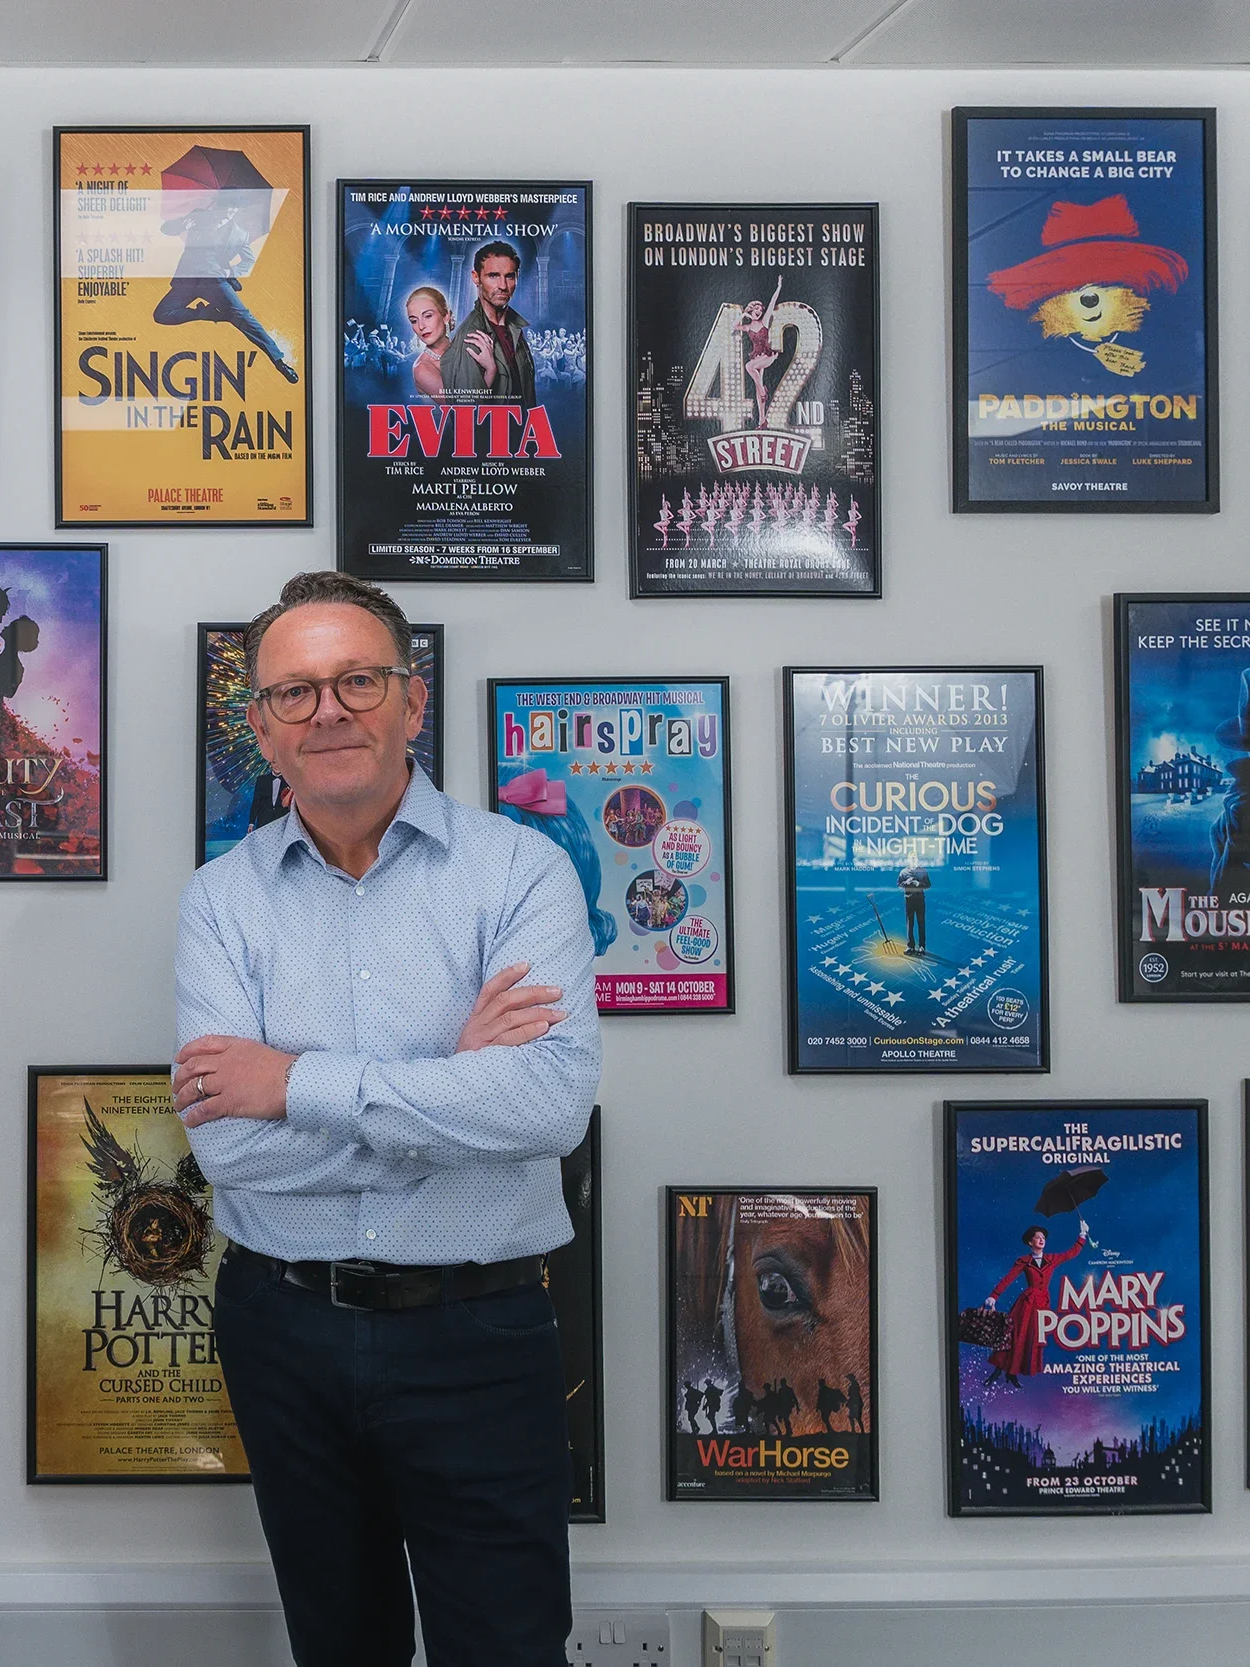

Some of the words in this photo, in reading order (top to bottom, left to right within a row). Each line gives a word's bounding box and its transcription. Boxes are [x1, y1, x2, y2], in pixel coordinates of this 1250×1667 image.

[997, 151, 1011, 163] IT
[1016, 151, 1065, 163] TAKES
[1068, 151, 1079, 163] A
[1082, 151, 1133, 163] SMALL
[1136, 151, 1176, 163] BEAR
[644, 223, 743, 242] BROADWAY’S
[750, 223, 815, 243] BIGGEST
[821, 224, 865, 243] SHOW
[644, 247, 664, 267] ON
[671, 247, 744, 267] LONDON’S
[751, 247, 814, 267] BIGGEST
[821, 248, 866, 267] STAGE
[684, 300, 823, 433] 42
[127, 406, 150, 428] IN
[154, 406, 198, 428] THE
[796, 401, 825, 426] ND
[202, 406, 293, 460] RAIN
[367, 404, 562, 459] EVITA
[717, 435, 804, 469] STREET
[412, 483, 459, 495] MARTI
[462, 483, 518, 496] PELLOW
[1052, 482, 1083, 491] SAVOY
[1085, 482, 1128, 491] THEATRE
[148, 489, 182, 503] PALACE
[185, 489, 223, 503] THEATRE
[416, 502, 468, 512] MADALENA
[470, 502, 513, 512] ALBERTO
[1195, 618, 1221, 632] SEE
[1226, 619, 1239, 632] IT
[1138, 635, 1174, 649] KEEP
[1180, 635, 1209, 649] THE
[820, 684, 1008, 712] WINNER!
[504, 708, 717, 758] hairspray
[821, 737, 875, 753] BEST
[885, 737, 940, 753] NEW
[951, 737, 1008, 753] PLAY
[830, 780, 997, 812] CURIOUS
[825, 815, 921, 834] INCIDENT
[938, 813, 1003, 835] DOG
[1143, 963, 1166, 973] 1952
[616, 981, 635, 994] MON
[637, 982, 643, 994] 9
[650, 981, 664, 994] SAT
[667, 981, 676, 994] 14
[678, 981, 715, 994] OCTOBER
[873, 1036, 964, 1047] CuriousOnStage.com
[881, 1050, 915, 1058] APOLLO
[918, 1050, 956, 1058] THEATRE
[1064, 1123, 1088, 1134] THE
[971, 1133, 1182, 1153] SUPERCALIFRAGILISTIC
[1042, 1153, 1110, 1164] ORIGINAL
[1061, 1272, 1165, 1312] MARY
[1036, 1305, 1185, 1349] POPPINS
[100, 1379, 164, 1393] CURSED
[169, 1379, 222, 1392] CHILD
[99, 1447, 133, 1455] PALACE
[136, 1447, 177, 1456] THEATRE,
[1027, 1477, 1060, 1487] FROM
[1064, 1477, 1079, 1487] 23
[1083, 1475, 1138, 1486] OCTOBER
